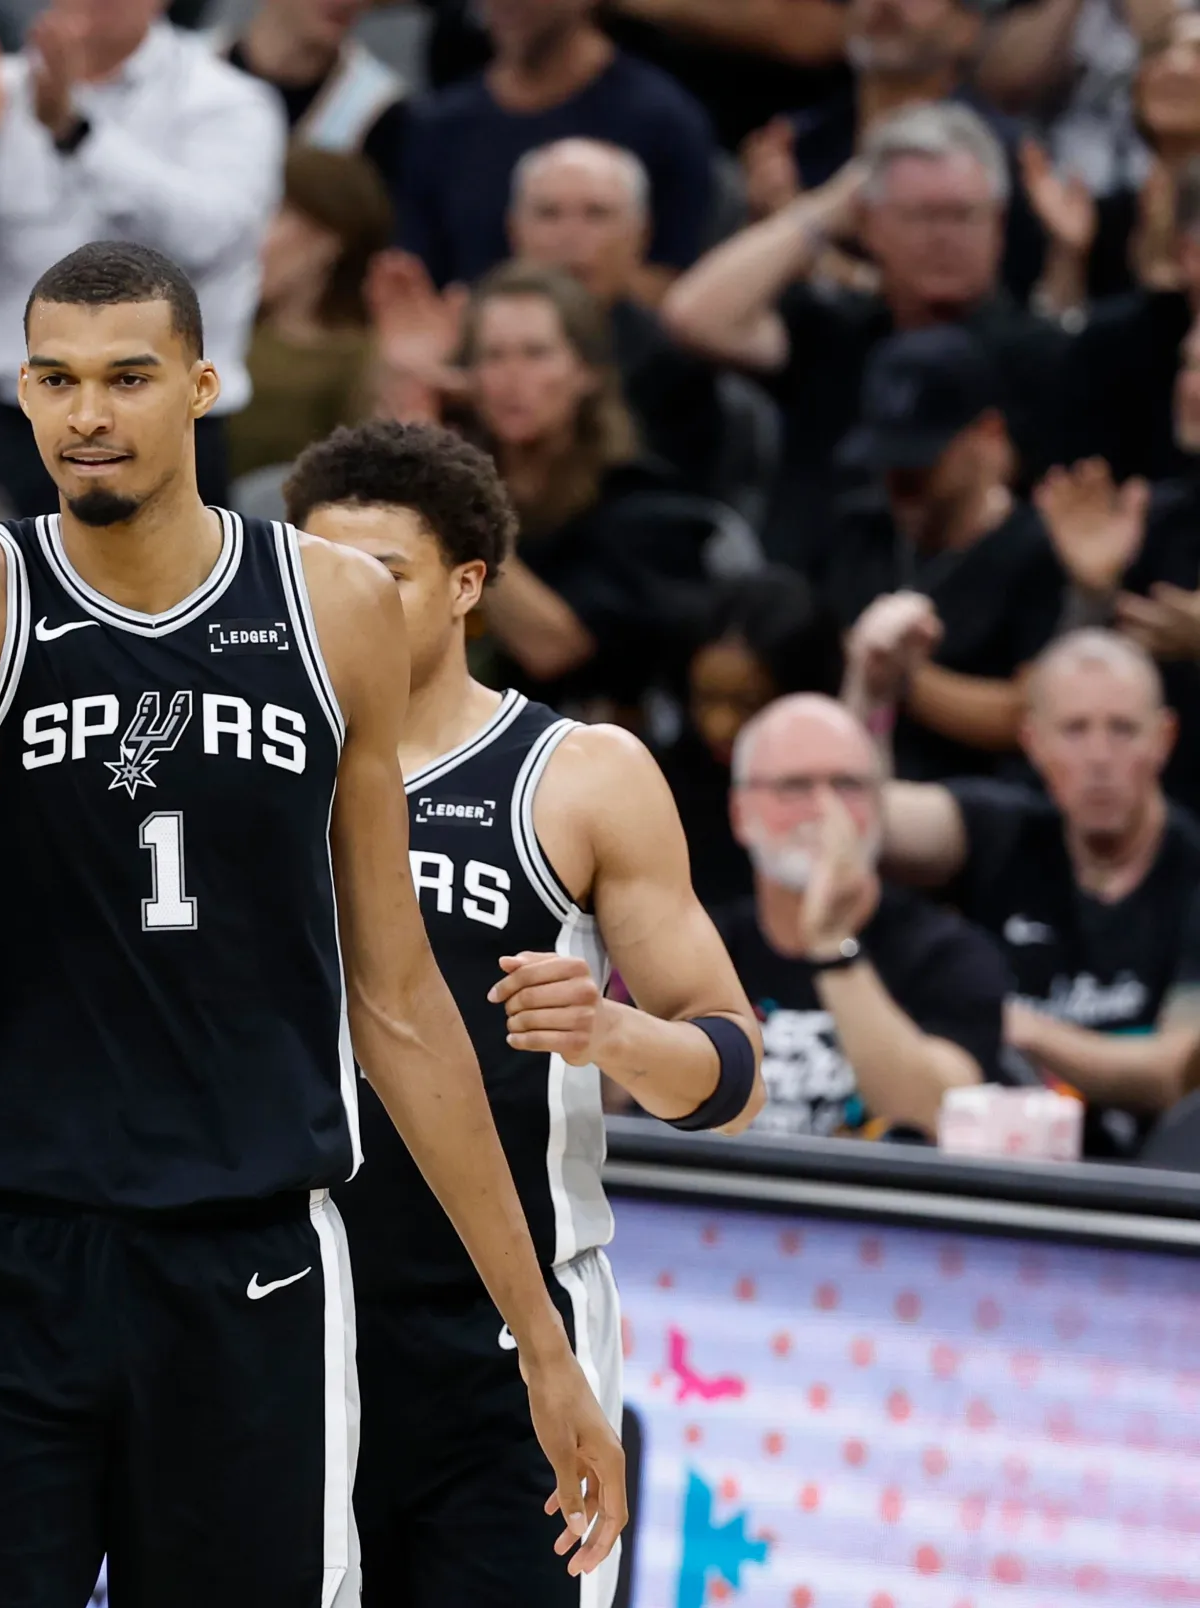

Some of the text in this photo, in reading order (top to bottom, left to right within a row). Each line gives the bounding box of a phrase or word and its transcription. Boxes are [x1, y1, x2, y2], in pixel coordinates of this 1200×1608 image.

[220, 630, 278, 644] LEDGER
[22, 690, 306, 800] SPURS
[426, 804, 485, 818] LEDGER
[139, 811, 198, 931] 1
